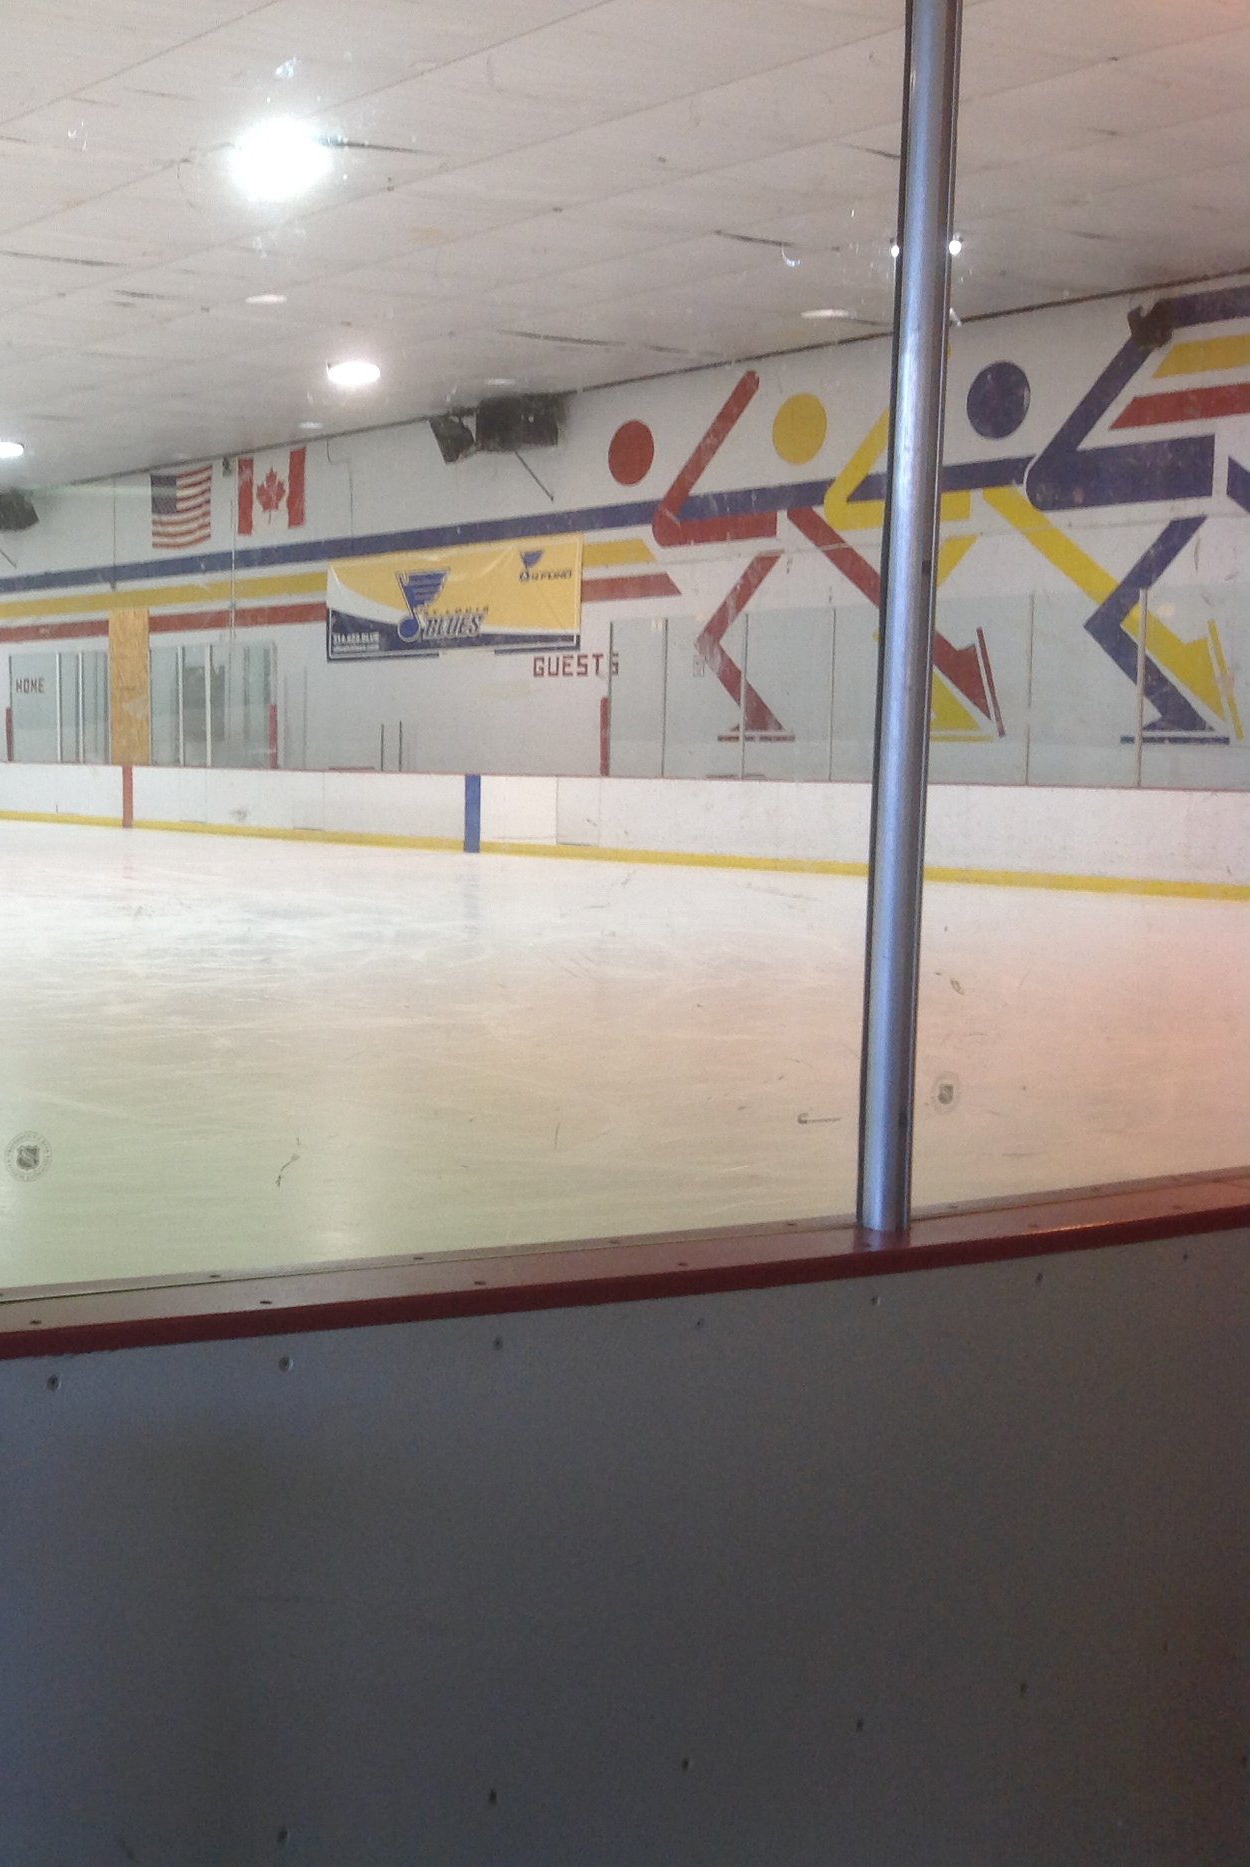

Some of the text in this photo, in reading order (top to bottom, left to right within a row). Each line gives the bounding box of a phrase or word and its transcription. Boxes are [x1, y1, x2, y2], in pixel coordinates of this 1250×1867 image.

[422, 614, 483, 640] BLUES
[533, 652, 619, 677] GUESTS
[15, 677, 46, 694] HOME
